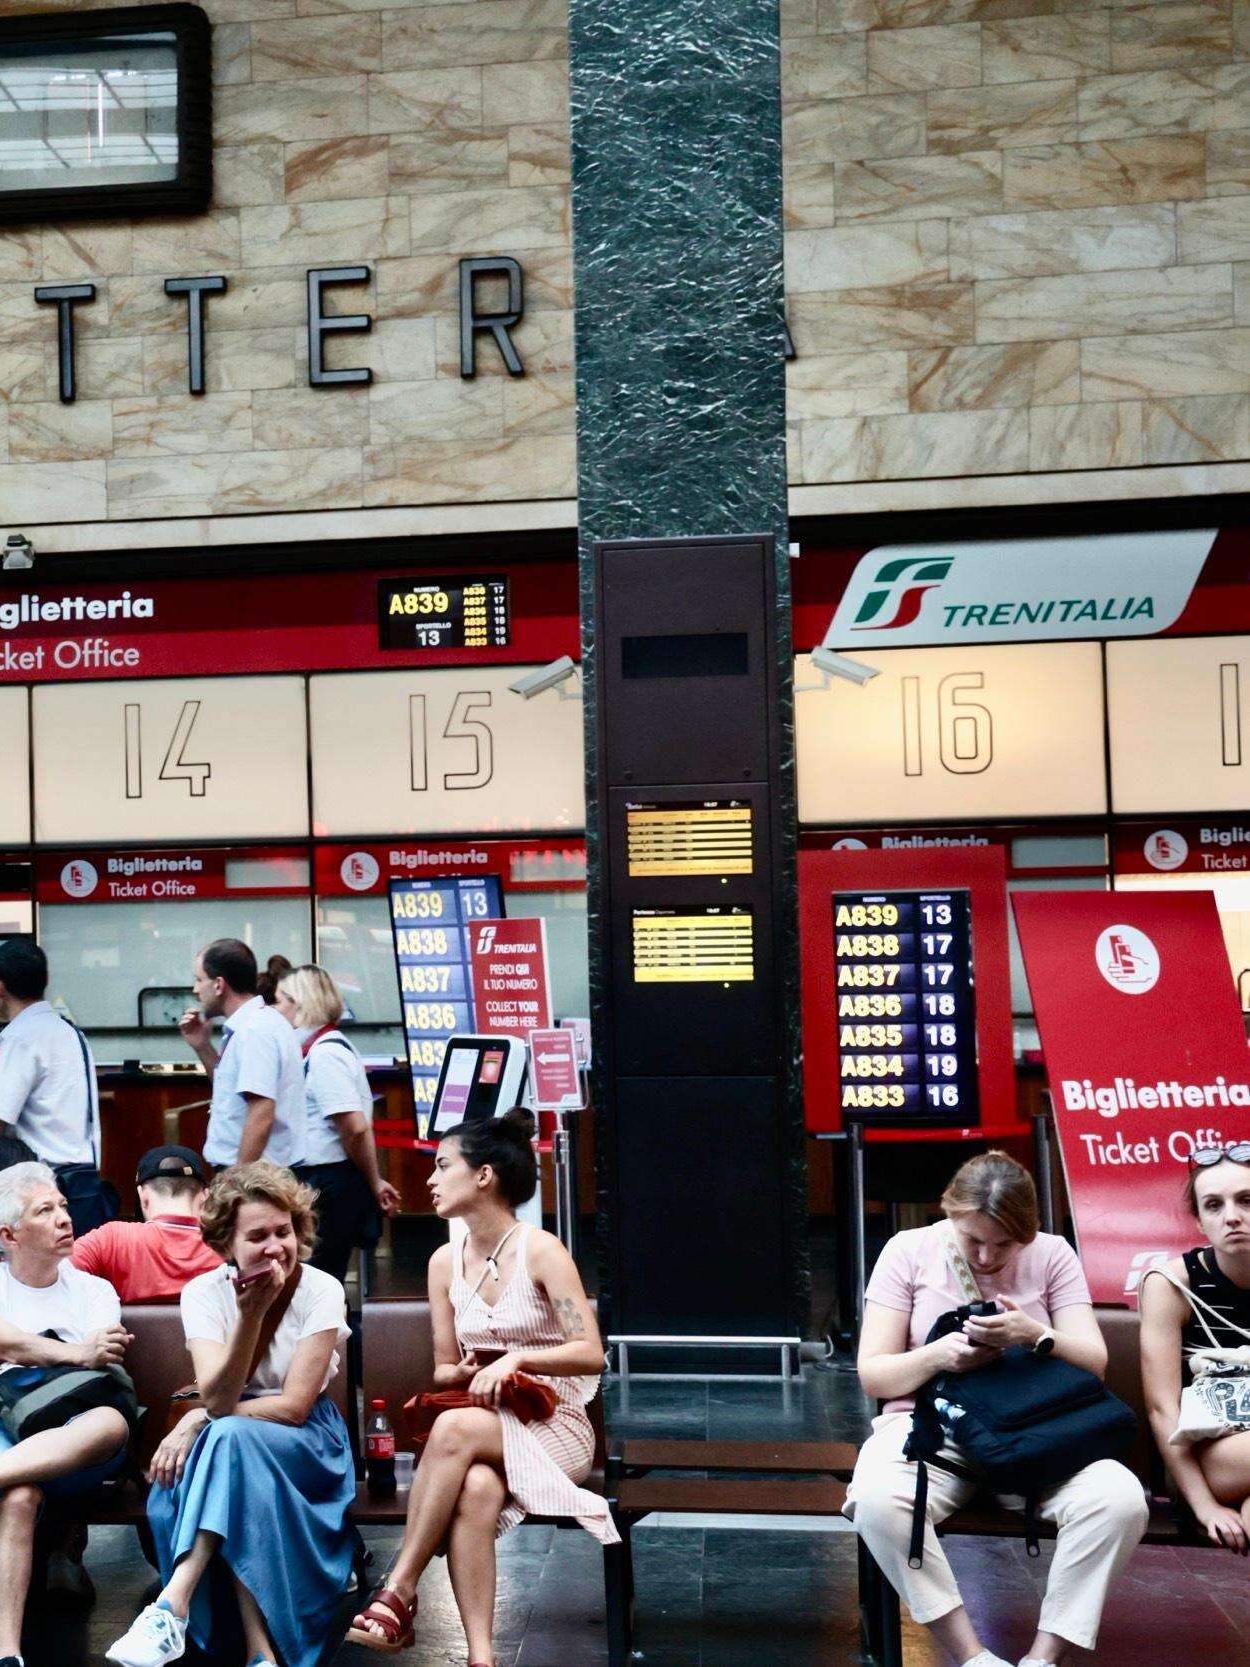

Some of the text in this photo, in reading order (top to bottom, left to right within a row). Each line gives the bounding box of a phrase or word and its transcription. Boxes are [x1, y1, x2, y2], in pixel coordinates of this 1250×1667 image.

[389, 592, 449, 615] A839
[943, 596, 1155, 628] TRENITALIA
[418, 630, 440, 646] 13
[52, 638, 140, 668] Office
[901, 671, 993, 777] 16
[1220, 662, 1242, 767] 1
[123, 700, 212, 799] 14
[409, 690, 495, 792] 15
[107, 856, 202, 874] Biglietteria
[389, 849, 489, 869] Biglietteria
[1201, 853, 1247, 869] Ticket
[109, 880, 196, 898] Ticket Office
[393, 892, 488, 918] A839 13
[835, 904, 952, 927] A839 13
[396, 930, 448, 955] A838
[494, 943, 537, 954] TRENITALIA
[836, 934, 953, 957] A838 17
[401, 967, 450, 992] A837
[489, 964, 514, 976] PRENDI
[837, 964, 954, 987] A837 17
[490, 980, 506, 991] TUO
[506, 979, 538, 990] NUMERO
[405, 1003, 456, 1029] A836
[486, 1001, 539, 1013] COLLECT YOUR
[838, 994, 956, 1017] A836 18
[489, 1016, 538, 1028] NUMBER HERE
[839, 1024, 957, 1047] A835 18
[410, 1041, 445, 1066] A83
[841, 1055, 958, 1077] A834 19
[841, 1085, 959, 1108] A833 16
[1061, 1076, 1250, 1118] Biglietteria
[1079, 1131, 1160, 1166] Ticket
